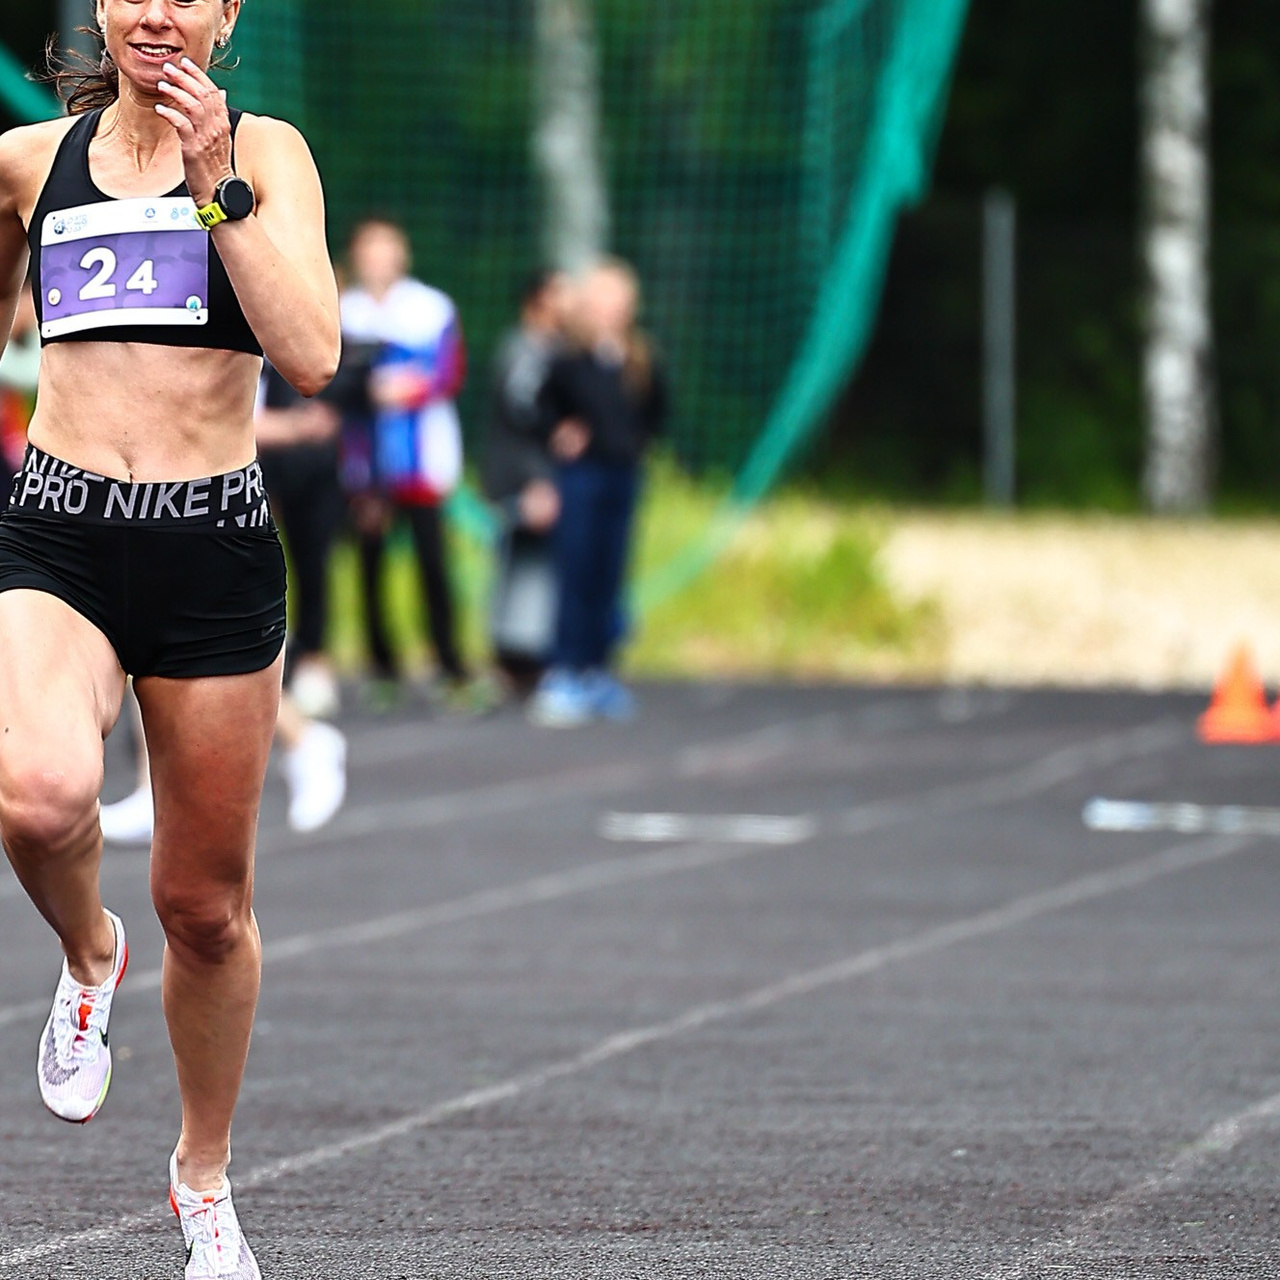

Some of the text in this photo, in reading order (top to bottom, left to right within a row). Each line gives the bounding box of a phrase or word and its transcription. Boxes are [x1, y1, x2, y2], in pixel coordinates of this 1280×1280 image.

[78, 245, 158, 301] 2 4
[19, 471, 89, 514] PRO
[104, 477, 211, 519] NIKE
[221, 462, 263, 511] PR
